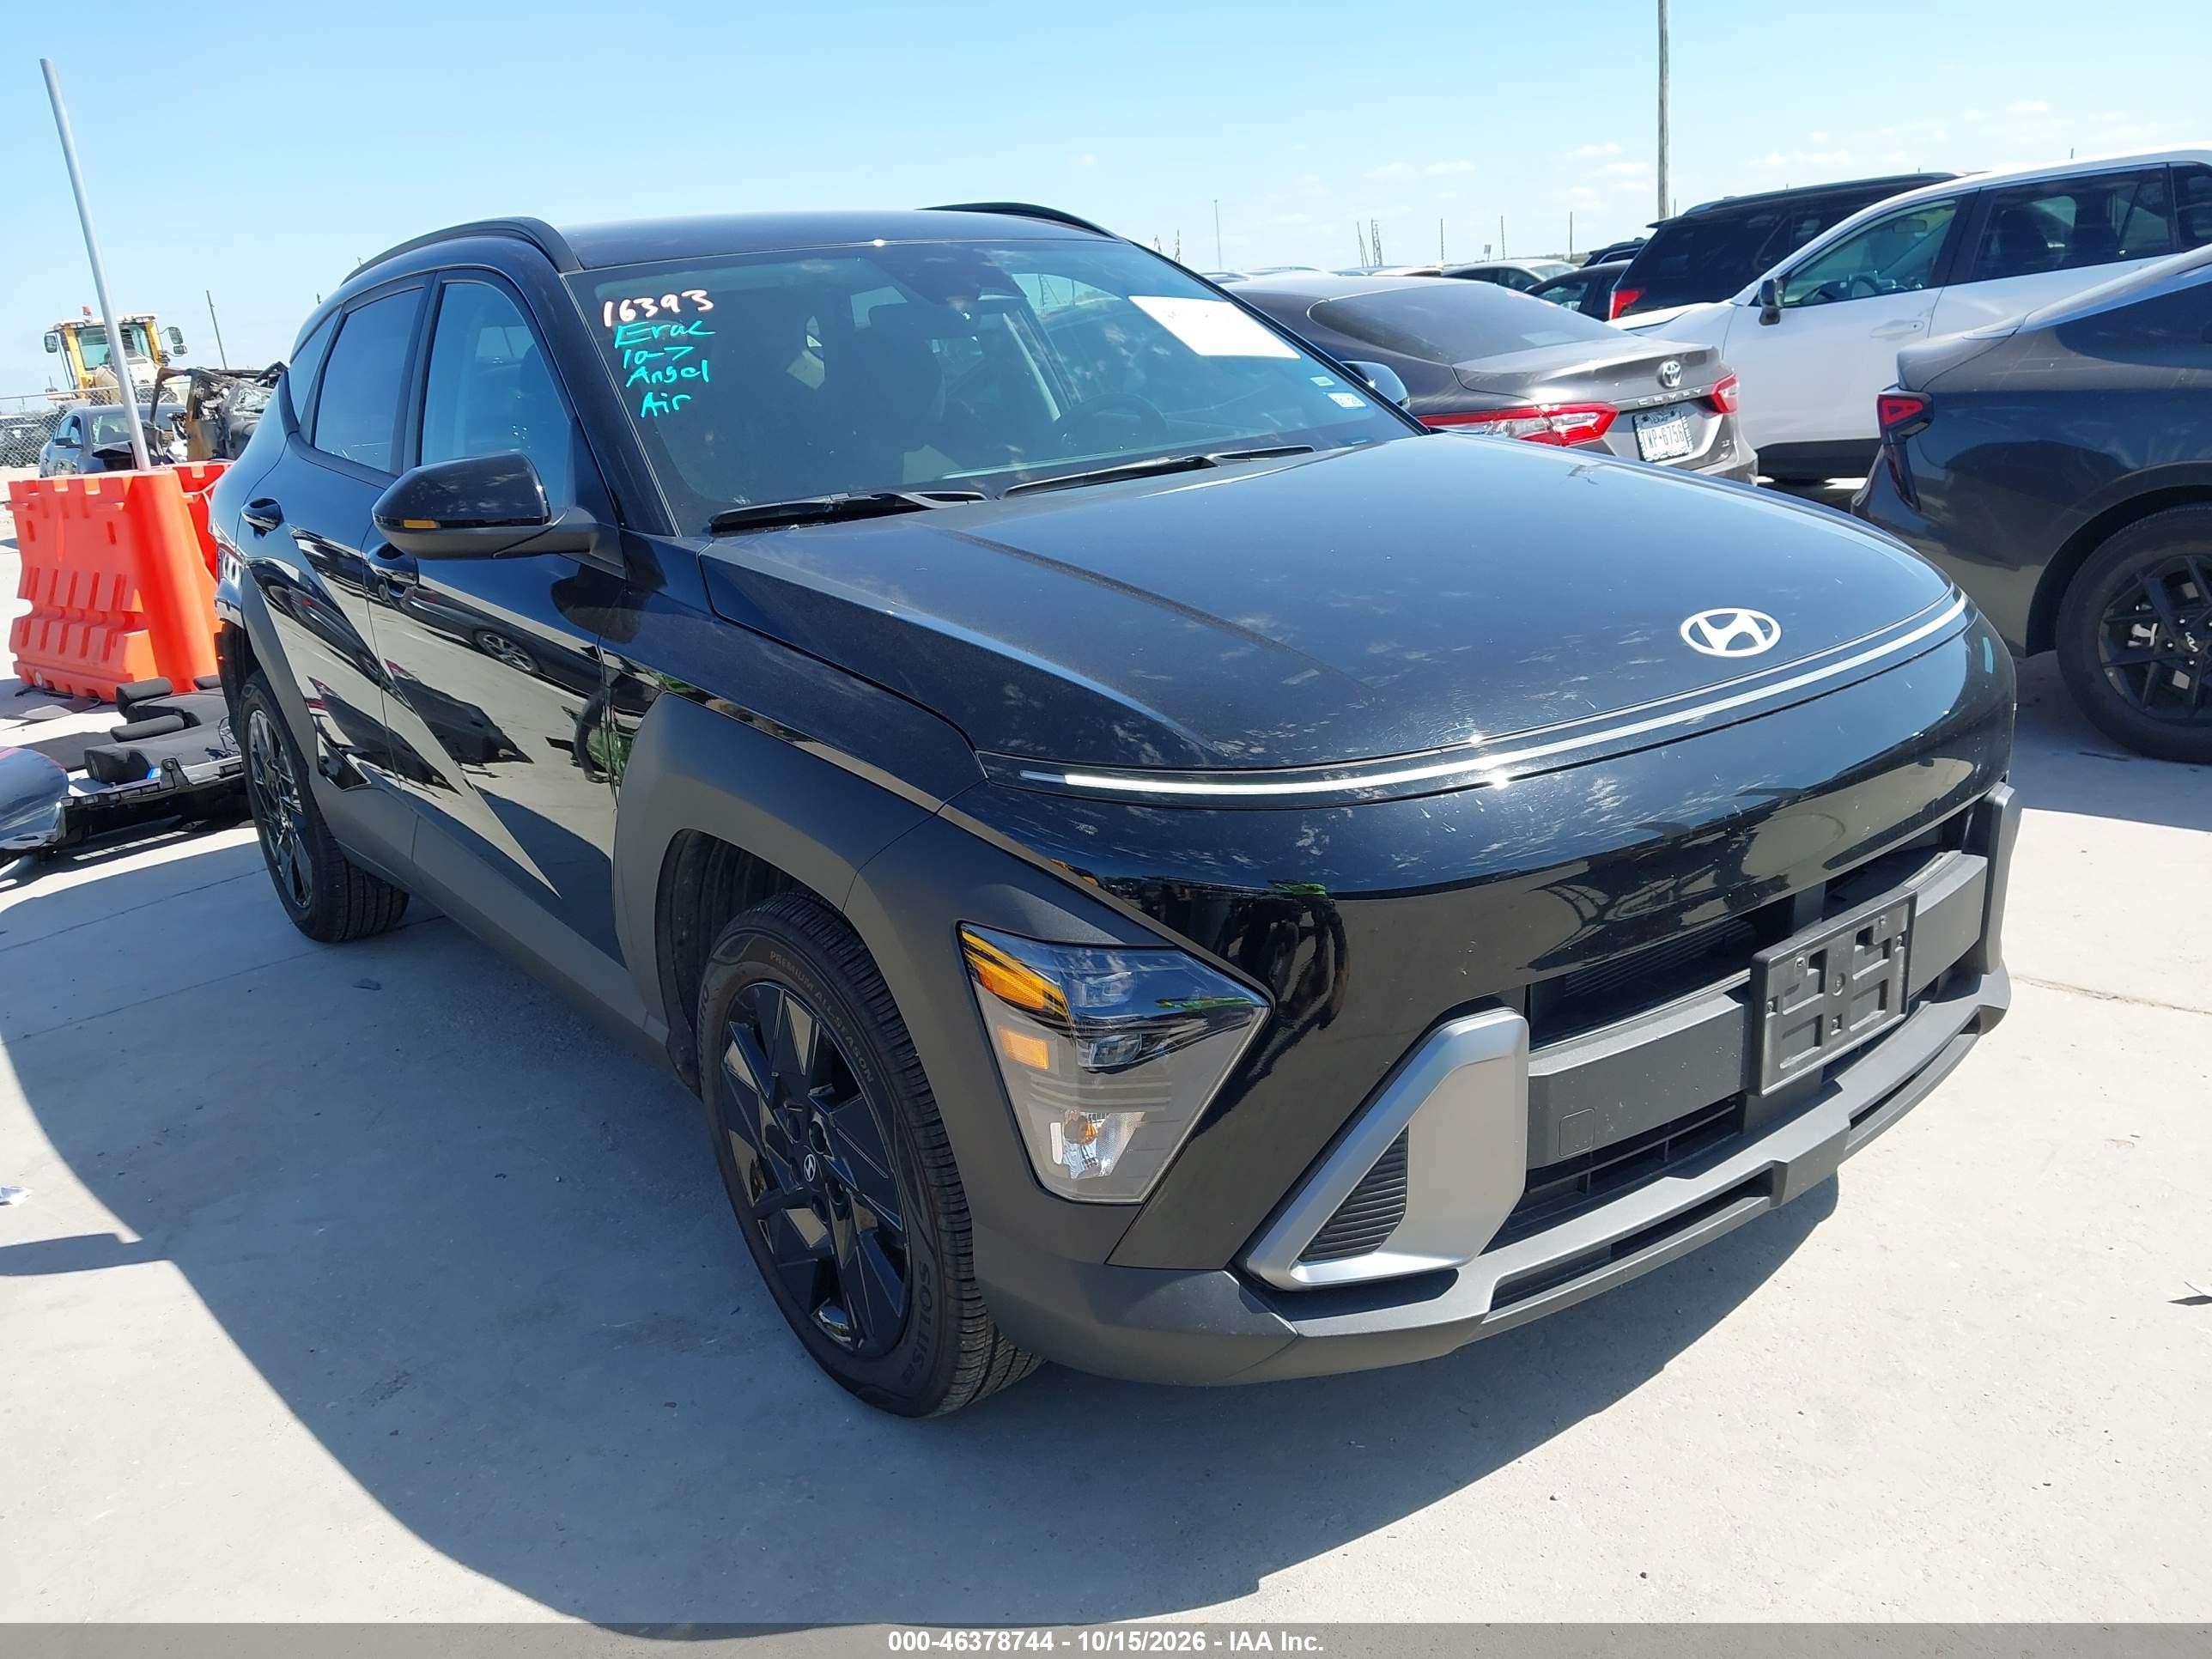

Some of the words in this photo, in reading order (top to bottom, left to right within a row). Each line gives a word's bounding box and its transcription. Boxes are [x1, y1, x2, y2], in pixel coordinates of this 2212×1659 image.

[603, 289, 714, 327] 16393
[641, 392, 692, 418] Air
[1638, 388, 1702, 405] CAMRY
[769, 950, 815, 992] PREMIUM
